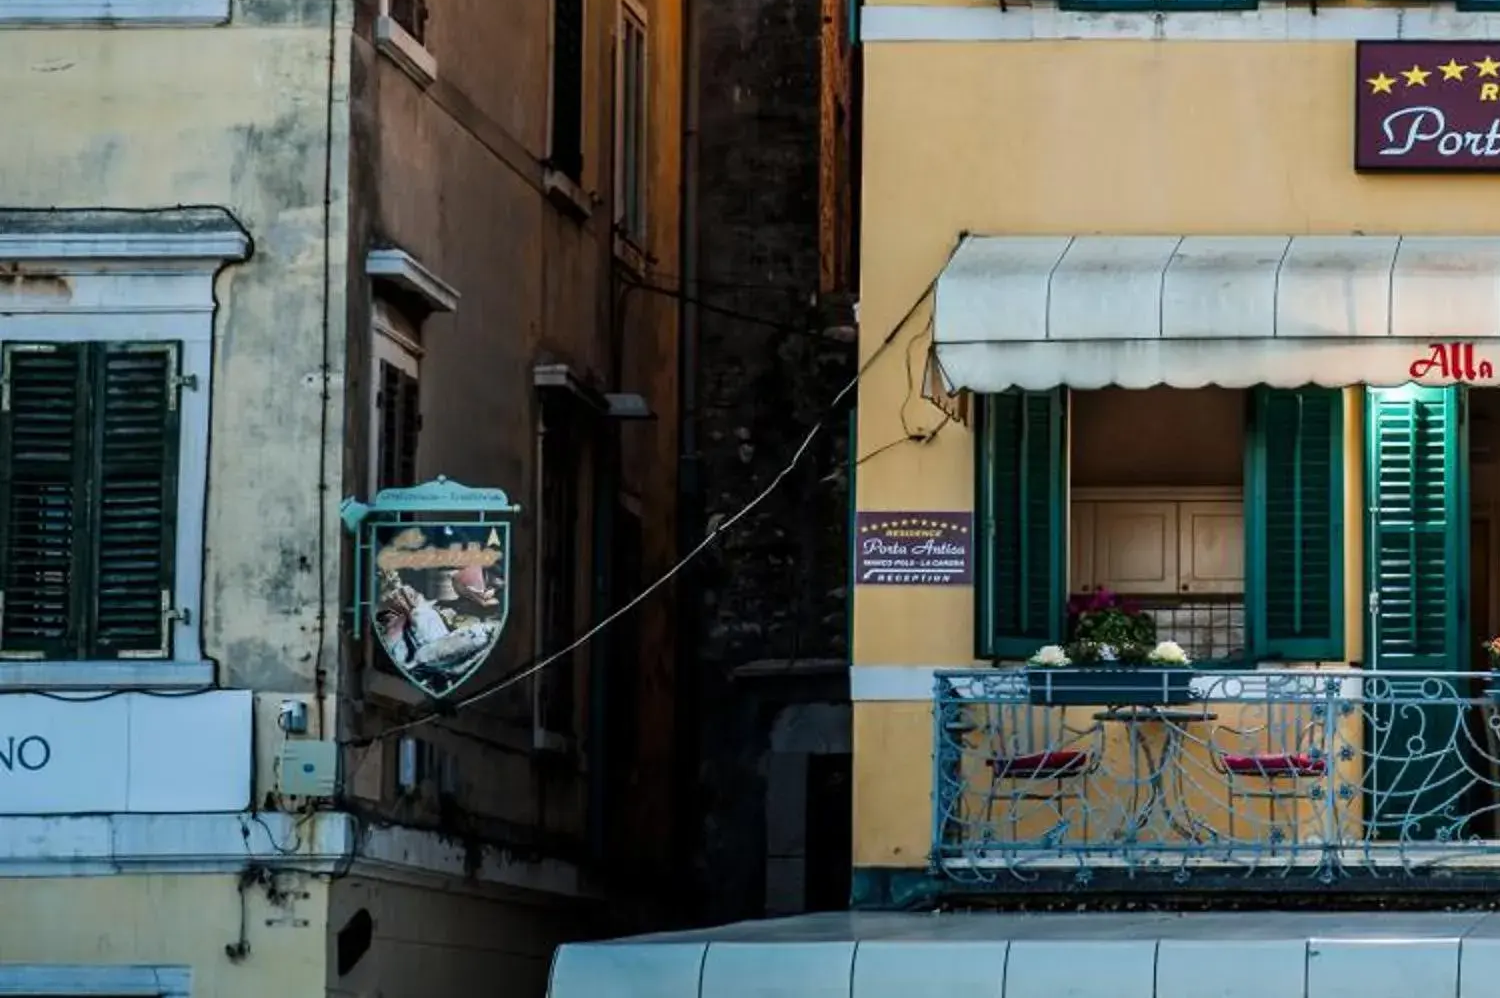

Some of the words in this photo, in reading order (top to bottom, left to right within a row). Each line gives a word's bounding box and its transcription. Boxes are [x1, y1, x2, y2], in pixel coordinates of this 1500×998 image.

[1409, 342, 1493, 381] Alla
[886, 529, 943, 538] RESIDENCE
[863, 537, 908, 555] Porta
[911, 538, 966, 556] Antica
